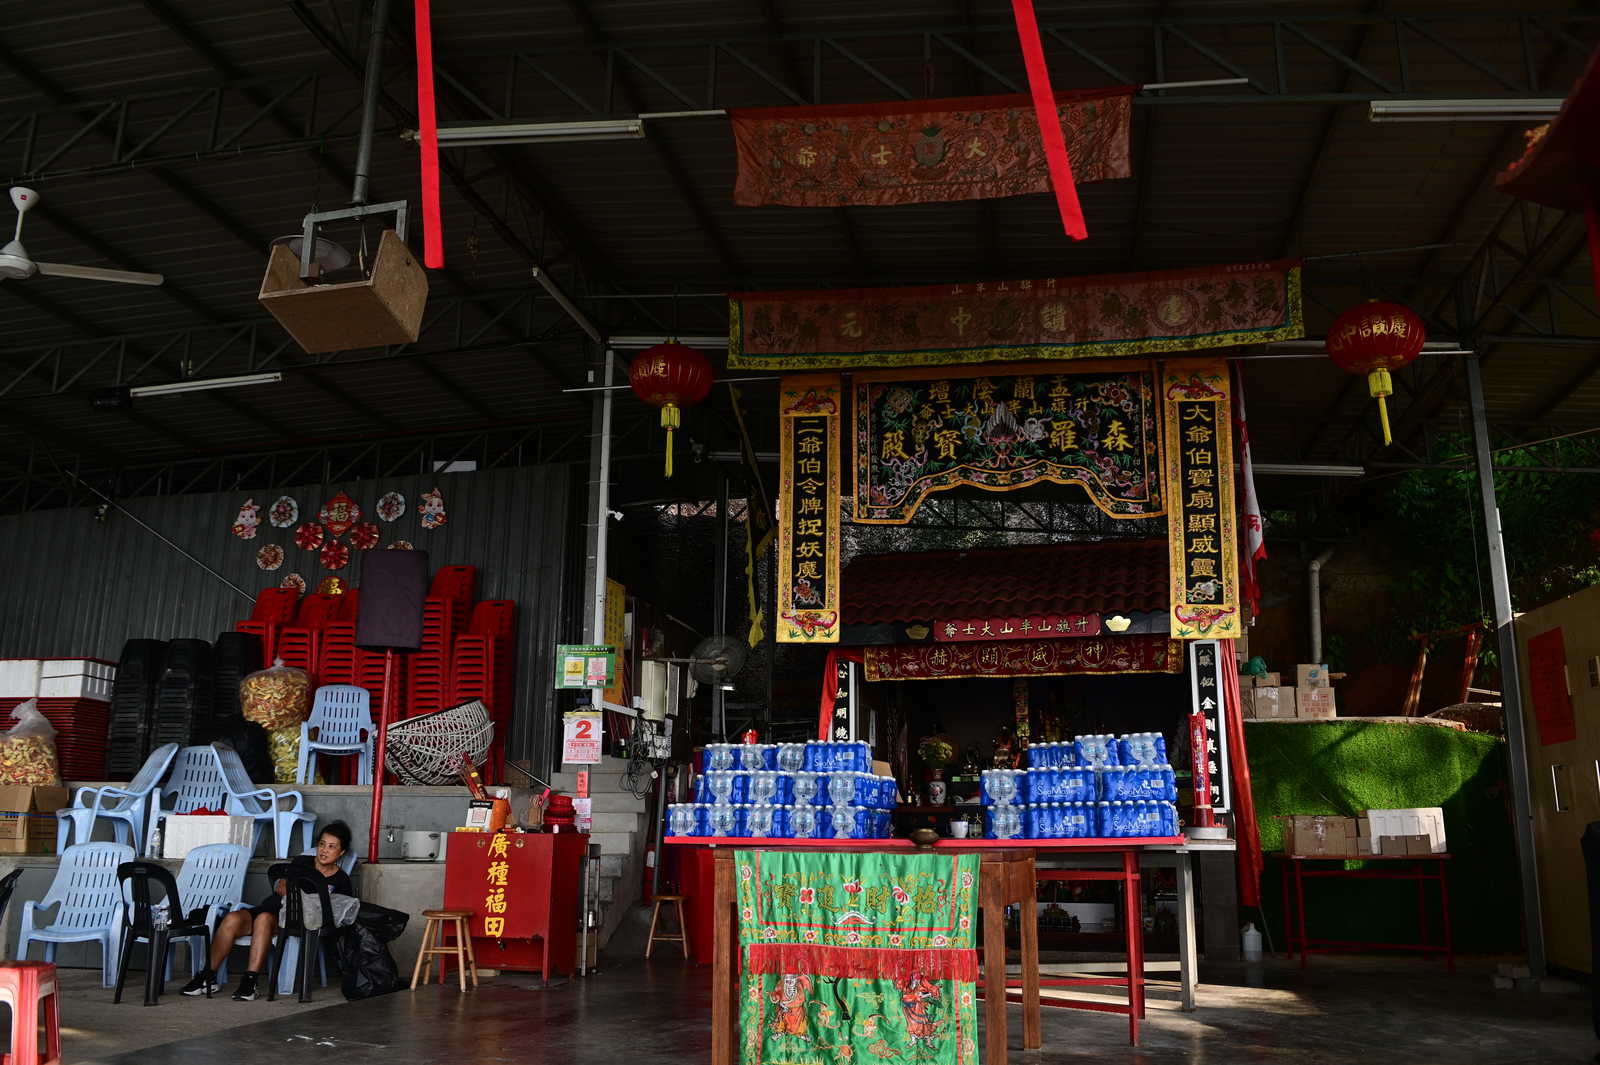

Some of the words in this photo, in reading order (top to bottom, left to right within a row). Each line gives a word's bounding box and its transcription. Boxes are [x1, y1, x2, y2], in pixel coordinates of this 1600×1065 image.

[881, 420, 1134, 460] 森羅寶殿
[1183, 404, 1218, 578] 大爺伯寶扇顯威靈
[796, 418, 824, 580] 二爺伯令牌捉妖魔
[576, 719, 592, 739] 2
[484, 833, 512, 938] 廣種福田
